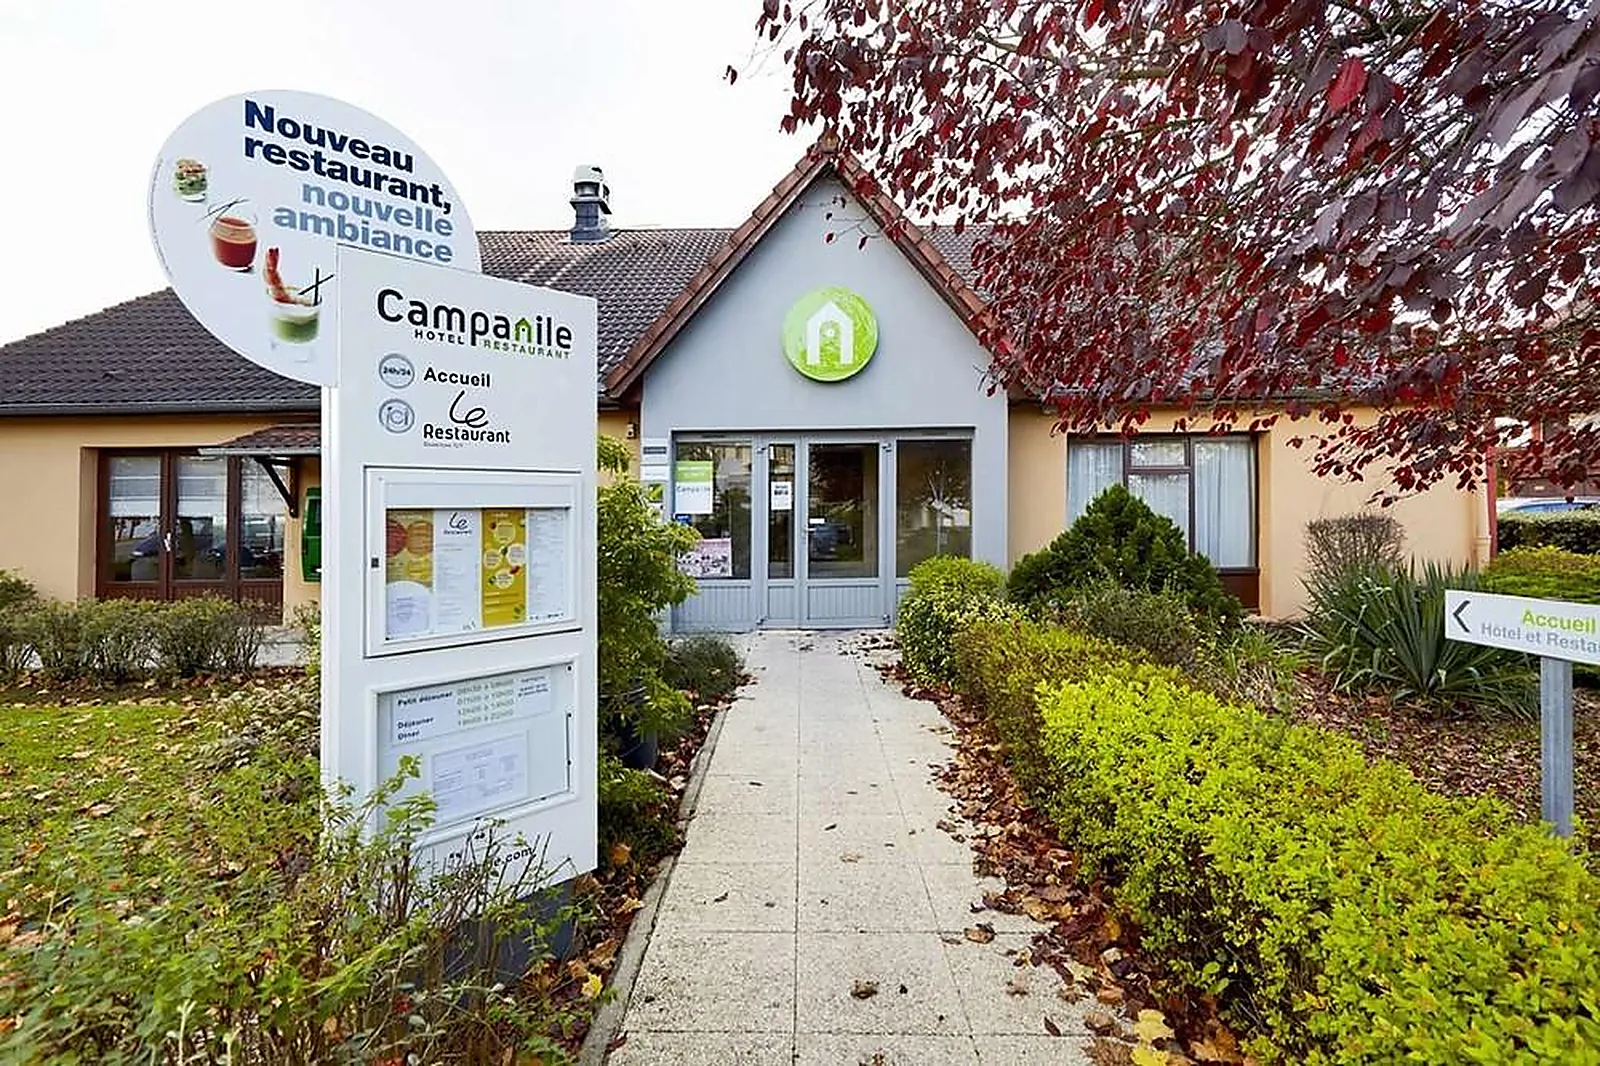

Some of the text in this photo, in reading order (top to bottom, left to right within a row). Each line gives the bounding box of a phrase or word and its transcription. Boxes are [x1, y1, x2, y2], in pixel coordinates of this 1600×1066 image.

[244, 100, 413, 173] Nouveau
[244, 137, 452, 214] restaurant,
[302, 183, 453, 236] nouvelle
[273, 206, 452, 262] ambiance
[377, 289, 572, 349] Campanile
[414, 329, 571, 360] HOTEL RESTAURANT
[424, 367, 491, 388] Accueil
[449, 390, 488, 428] Le
[423, 424, 511, 443] Restaurant
[1522, 611, 1596, 634] Accueil
[1526, 632, 1541, 643] et
[1547, 632, 1600, 653] Resta
